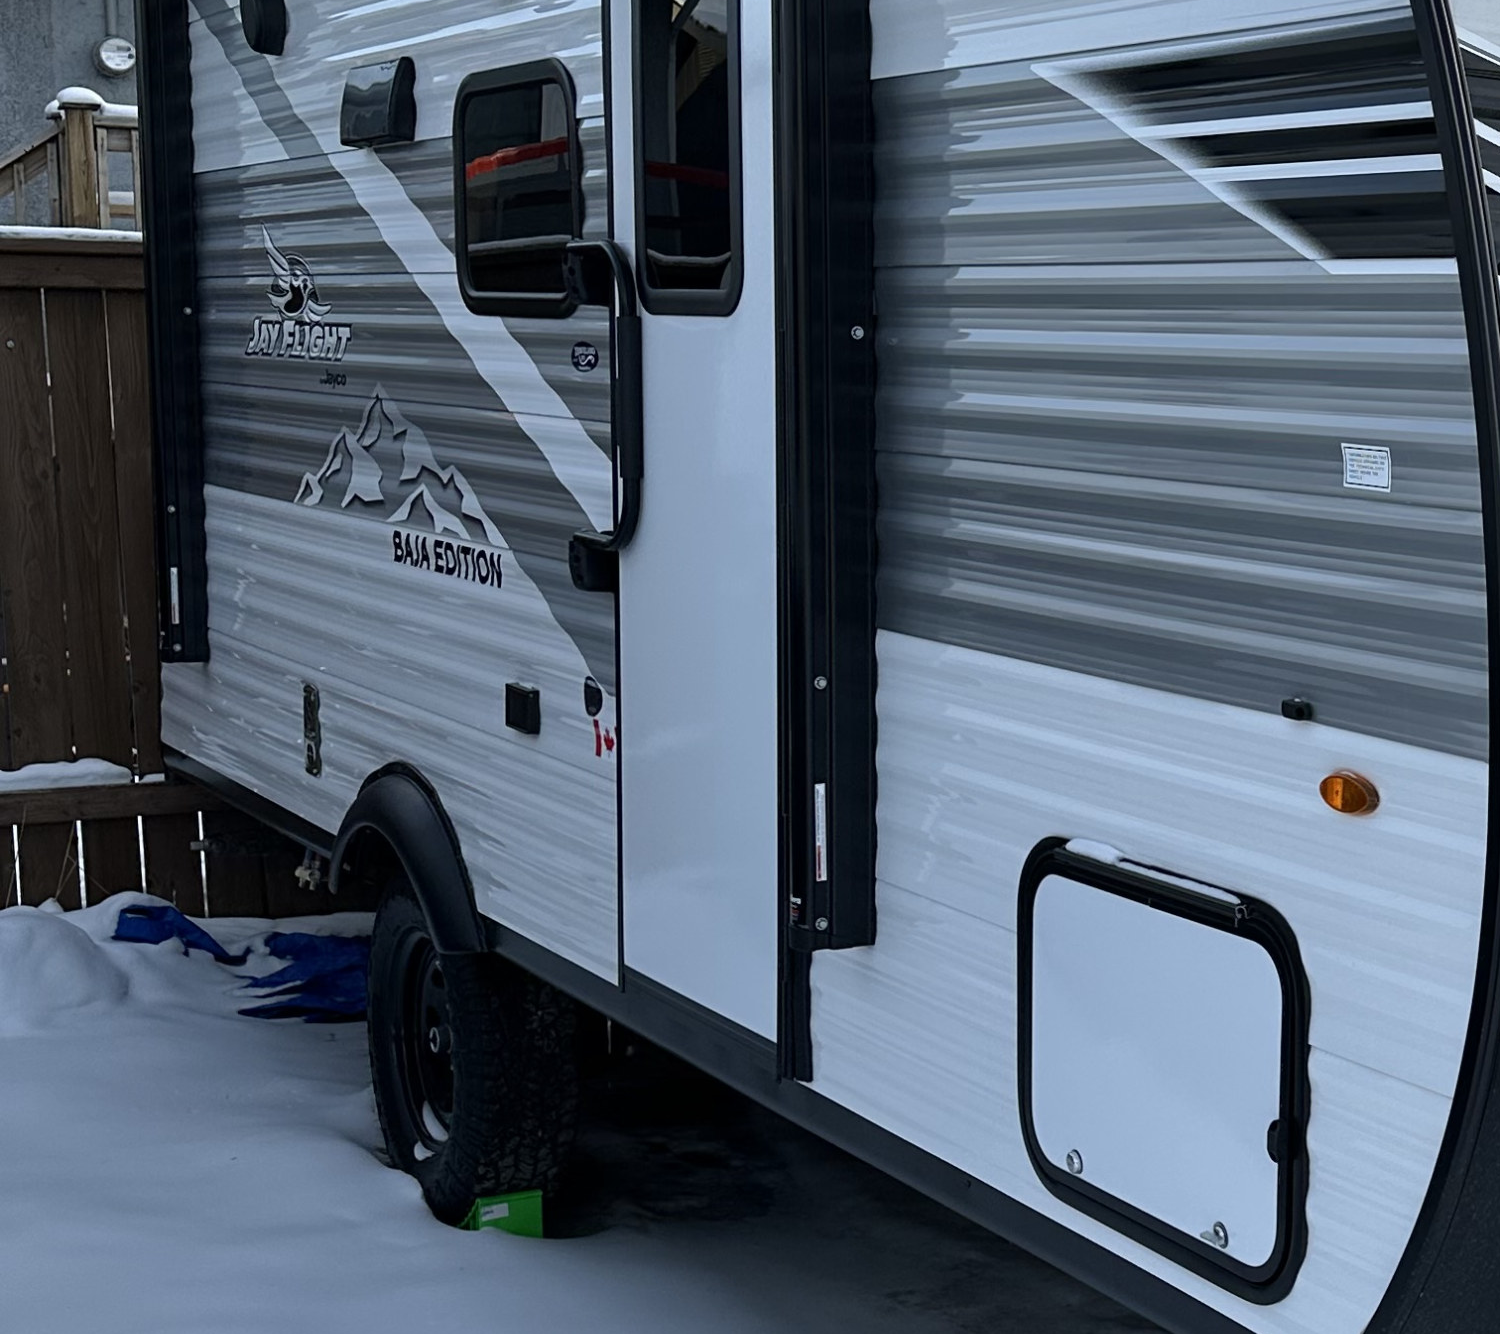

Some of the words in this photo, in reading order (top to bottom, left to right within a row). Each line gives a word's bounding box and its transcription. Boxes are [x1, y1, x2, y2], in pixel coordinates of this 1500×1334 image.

[246, 316, 280, 357] JAY
[278, 319, 352, 362] FLIGHT
[393, 530, 430, 571] BAJA
[434, 539, 502, 589] EDITION
